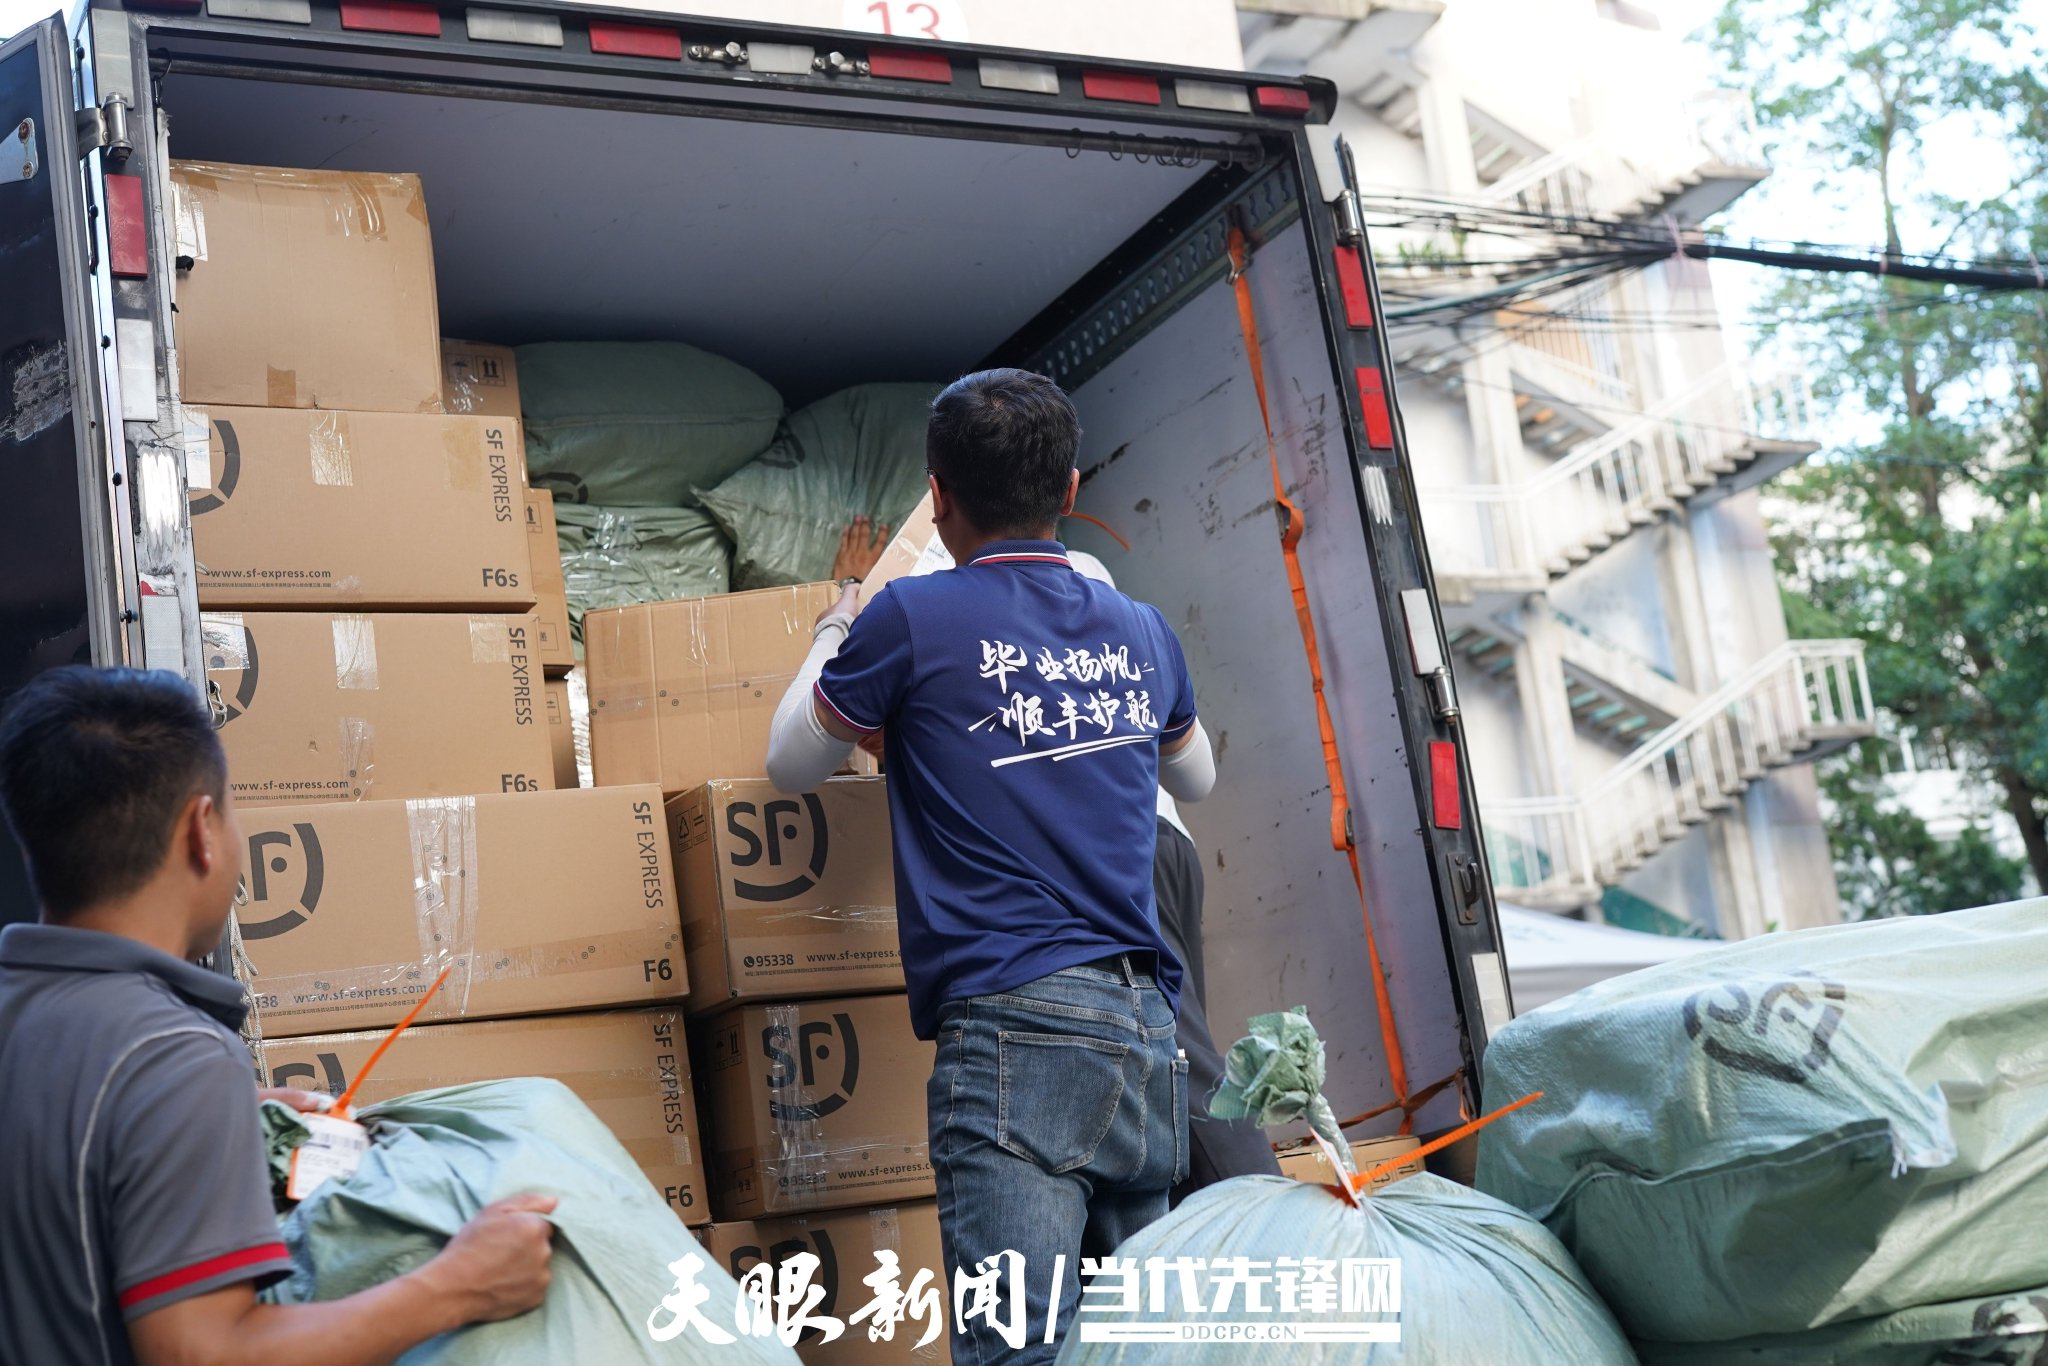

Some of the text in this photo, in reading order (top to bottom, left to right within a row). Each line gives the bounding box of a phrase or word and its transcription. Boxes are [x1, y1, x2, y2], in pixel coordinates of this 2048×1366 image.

[867, 1, 941, 40] 13
[486, 429, 512, 522] SF EXPRESS
[211, 568, 331, 580] www.sf-express.com
[482, 567, 519, 588] F6s
[509, 627, 532, 725] SF EXPRESS
[979, 640, 1141, 694] 毕业扬帆
[997, 689, 1158, 747] 顺丰护航
[501, 774, 538, 793] F6s
[632, 801, 664, 909] SF EXPRESS
[643, 958, 673, 983] F6
[756, 954, 794, 967] 95338
[653, 1023, 684, 1134] SF EXPRESS
[665, 1184, 694, 1208] F6
